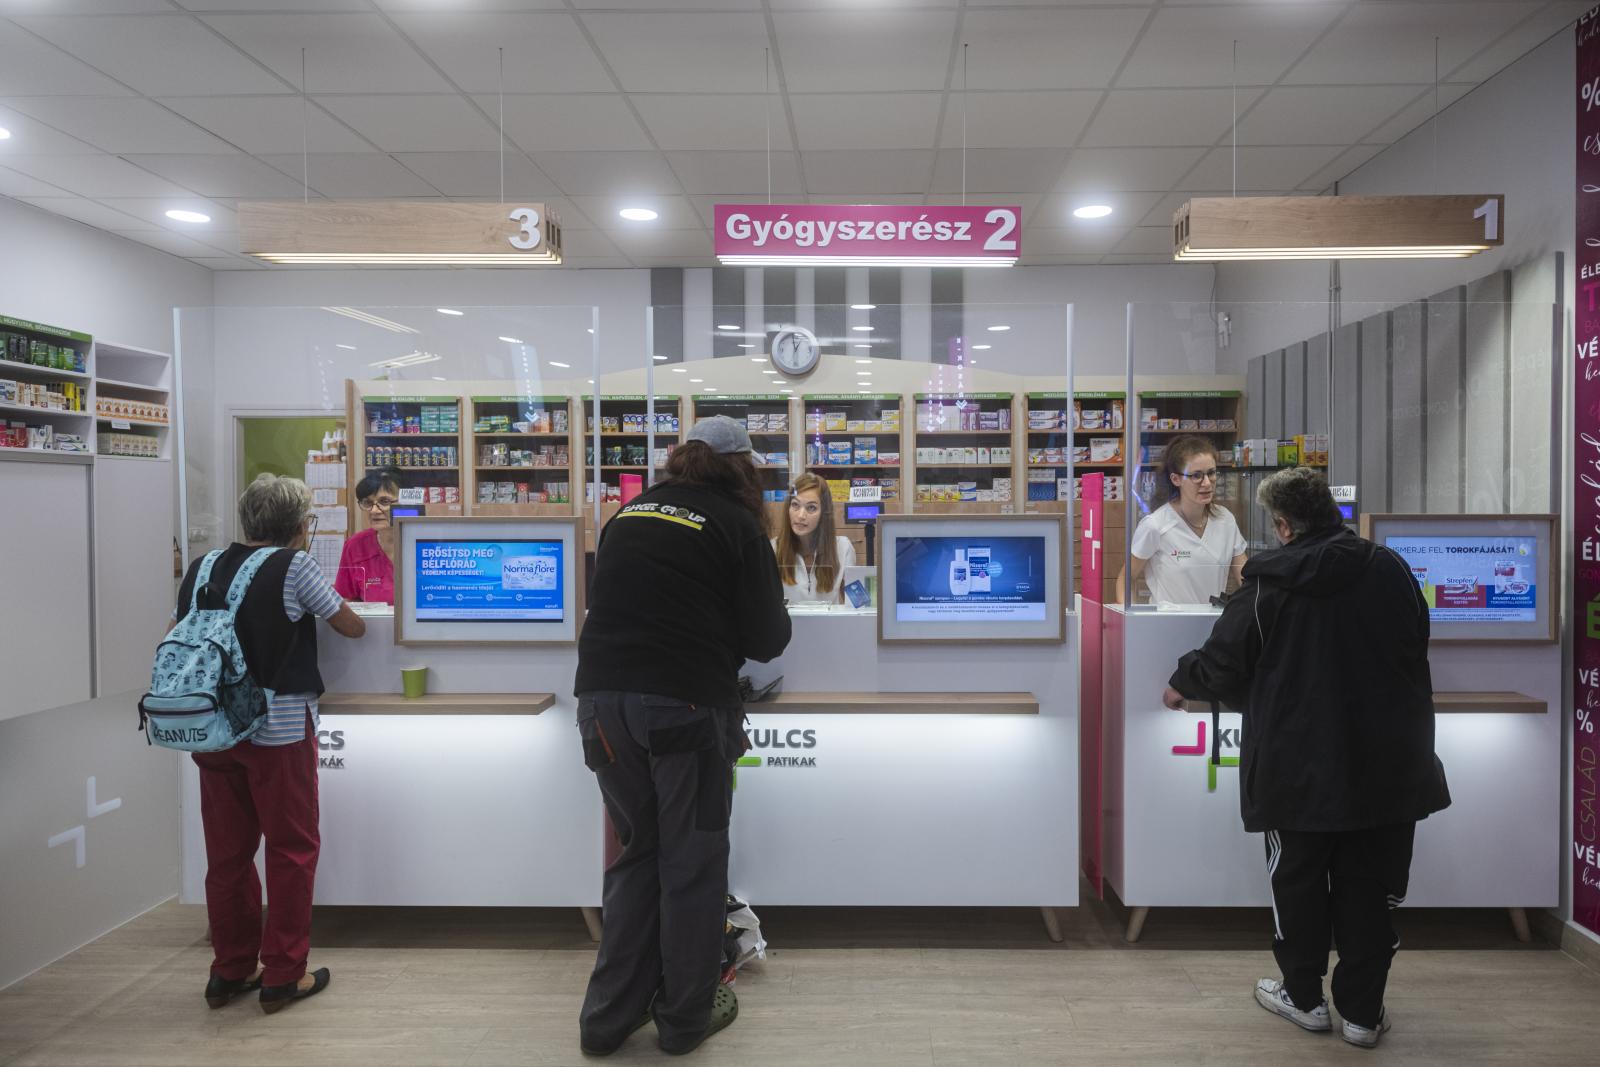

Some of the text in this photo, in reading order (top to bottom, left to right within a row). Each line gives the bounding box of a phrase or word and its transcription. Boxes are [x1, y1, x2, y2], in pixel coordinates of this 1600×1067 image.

[508, 208, 541, 249] 3
[726, 209, 1017, 250] Gyógyszerész 2
[1473, 199, 1498, 240] 1
[472, 548, 494, 558] MEG
[1428, 546, 1443, 554] FEL
[1445, 544, 1515, 554] TOROKFÁJÁSÁT!
[503, 565, 555, 575] Normaflore
[1577, 709, 1594, 733] %
[154, 726, 208, 743] PEANUTS
[745, 728, 817, 749] ULCS
[1575, 842, 1600, 868] VÉ
